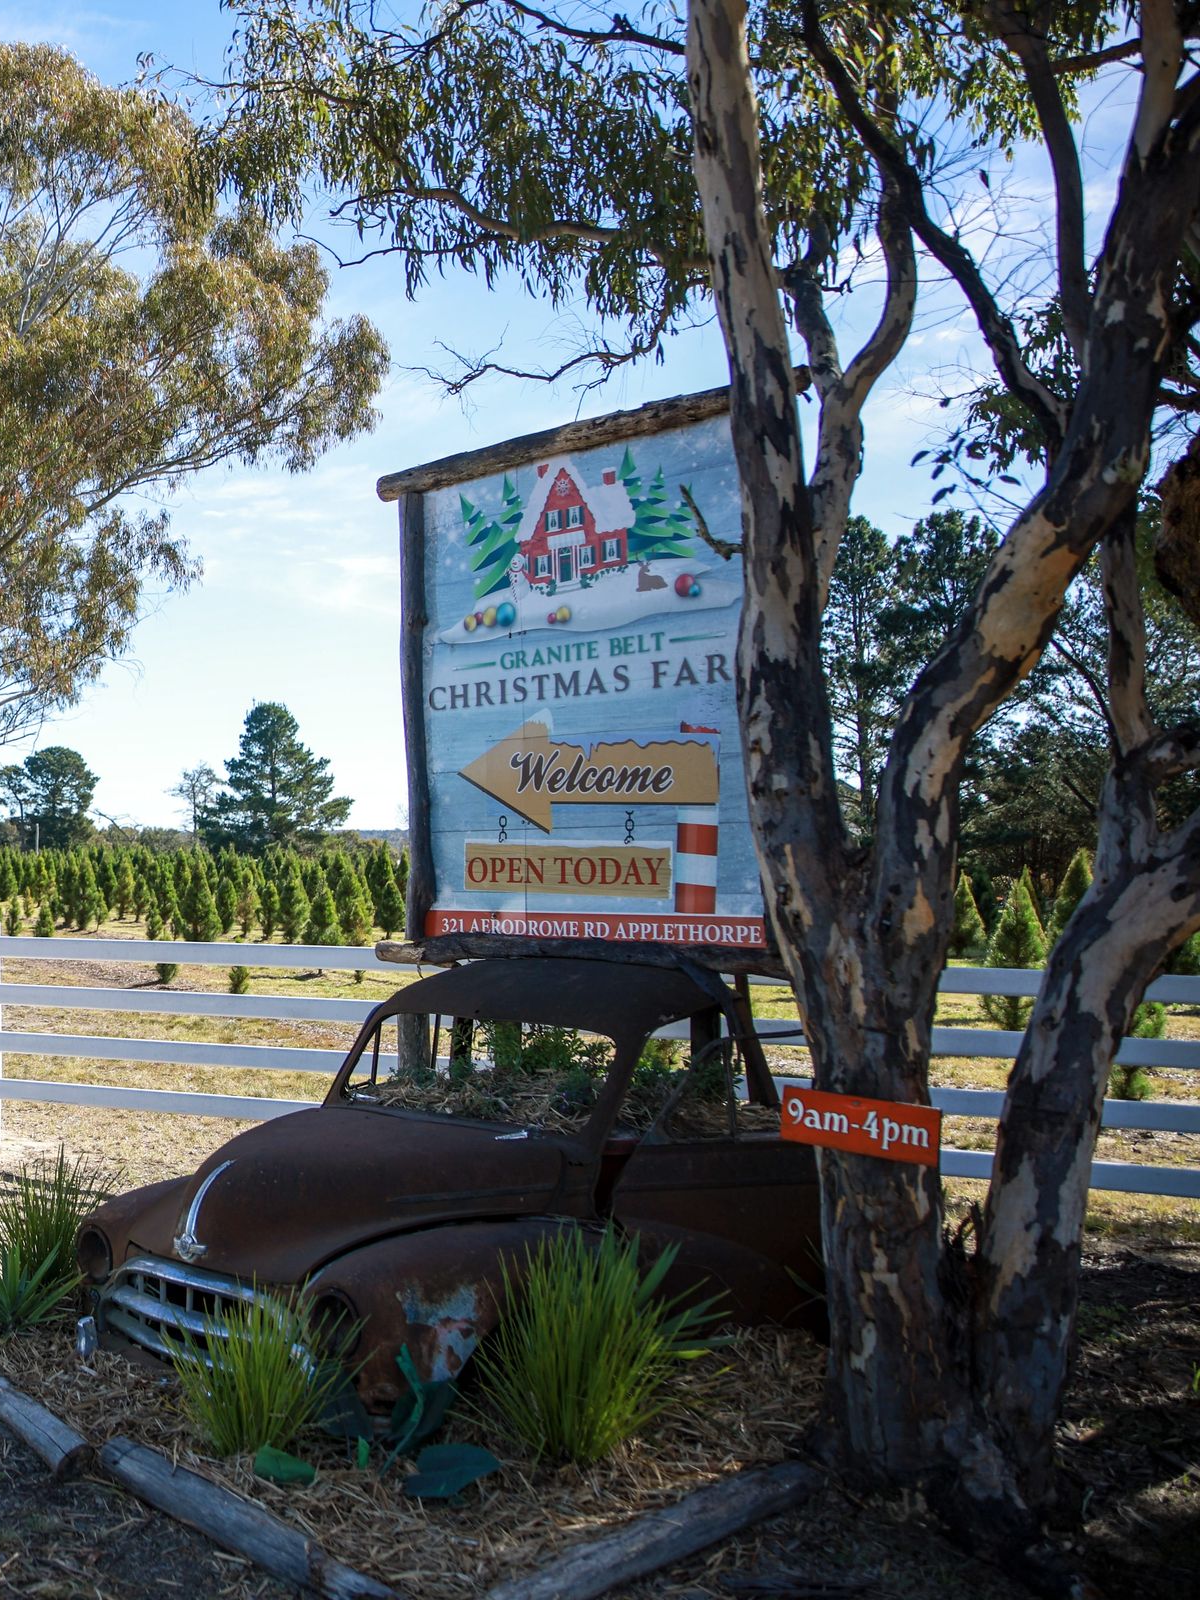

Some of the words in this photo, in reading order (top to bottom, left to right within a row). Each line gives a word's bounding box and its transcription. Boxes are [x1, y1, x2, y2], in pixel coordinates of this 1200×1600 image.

[500, 640, 599, 670] GRANITE
[608, 632, 665, 657] BELT
[429, 664, 630, 711] CHRISTMAS
[651, 653, 733, 689] FAR
[509, 749, 674, 794] Welcome
[466, 856, 545, 884] OPEN
[553, 856, 666, 886] TODAY
[441, 918, 465, 933] 321
[469, 918, 579, 937] AERODROME
[583, 921, 610, 940] RD
[614, 922, 762, 944] APPLETHORPE
[787, 1098, 929, 1150] 9am-4pm
